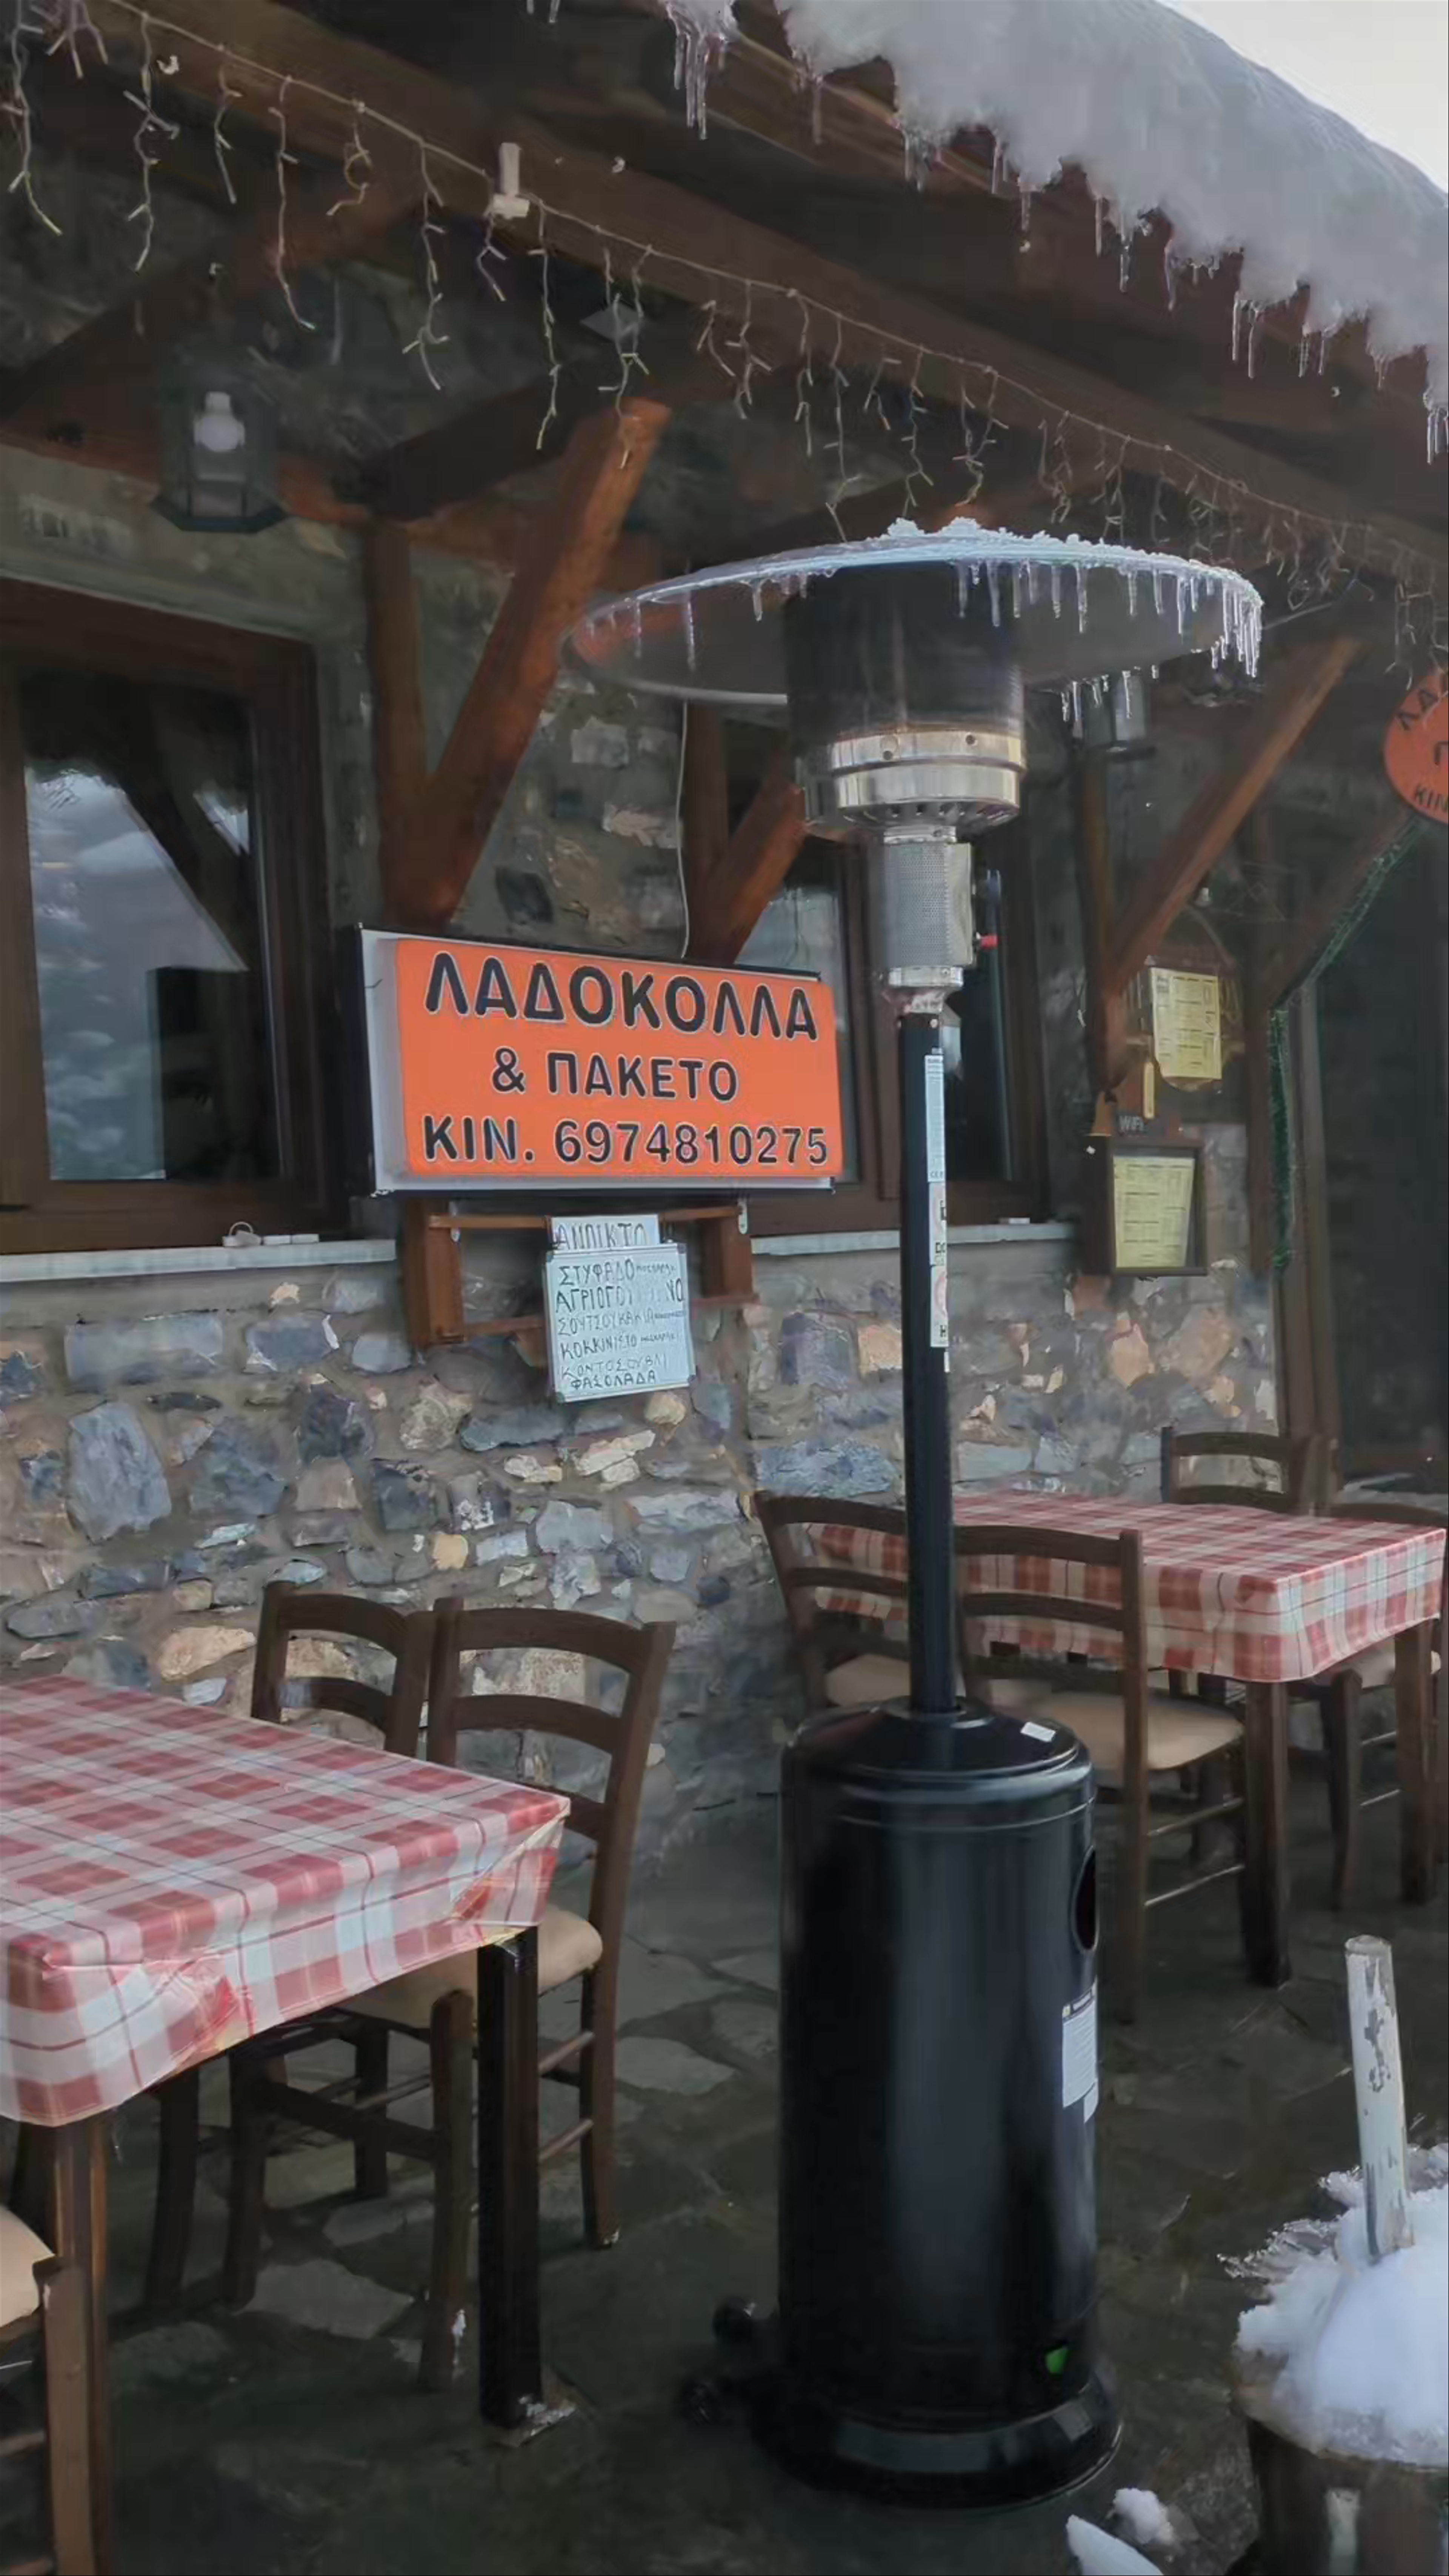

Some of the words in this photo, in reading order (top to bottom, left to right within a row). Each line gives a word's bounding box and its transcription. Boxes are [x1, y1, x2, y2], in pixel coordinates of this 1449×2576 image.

[425, 952, 818, 1040] ΛΑΔΟΚΟΛΛΑ
[492, 1047, 525, 1093] &
[547, 1051, 738, 1102] ΠΑΚΕΤΟ
[423, 1115, 534, 1162] ΚΙΝ.
[555, 1119, 828, 1165] 6974810275
[558, 1258, 635, 1286] ΣΤΥΦΑΔΟ
[571, 1370, 656, 1390] ΦΑΣΟΛΑΔΑ
